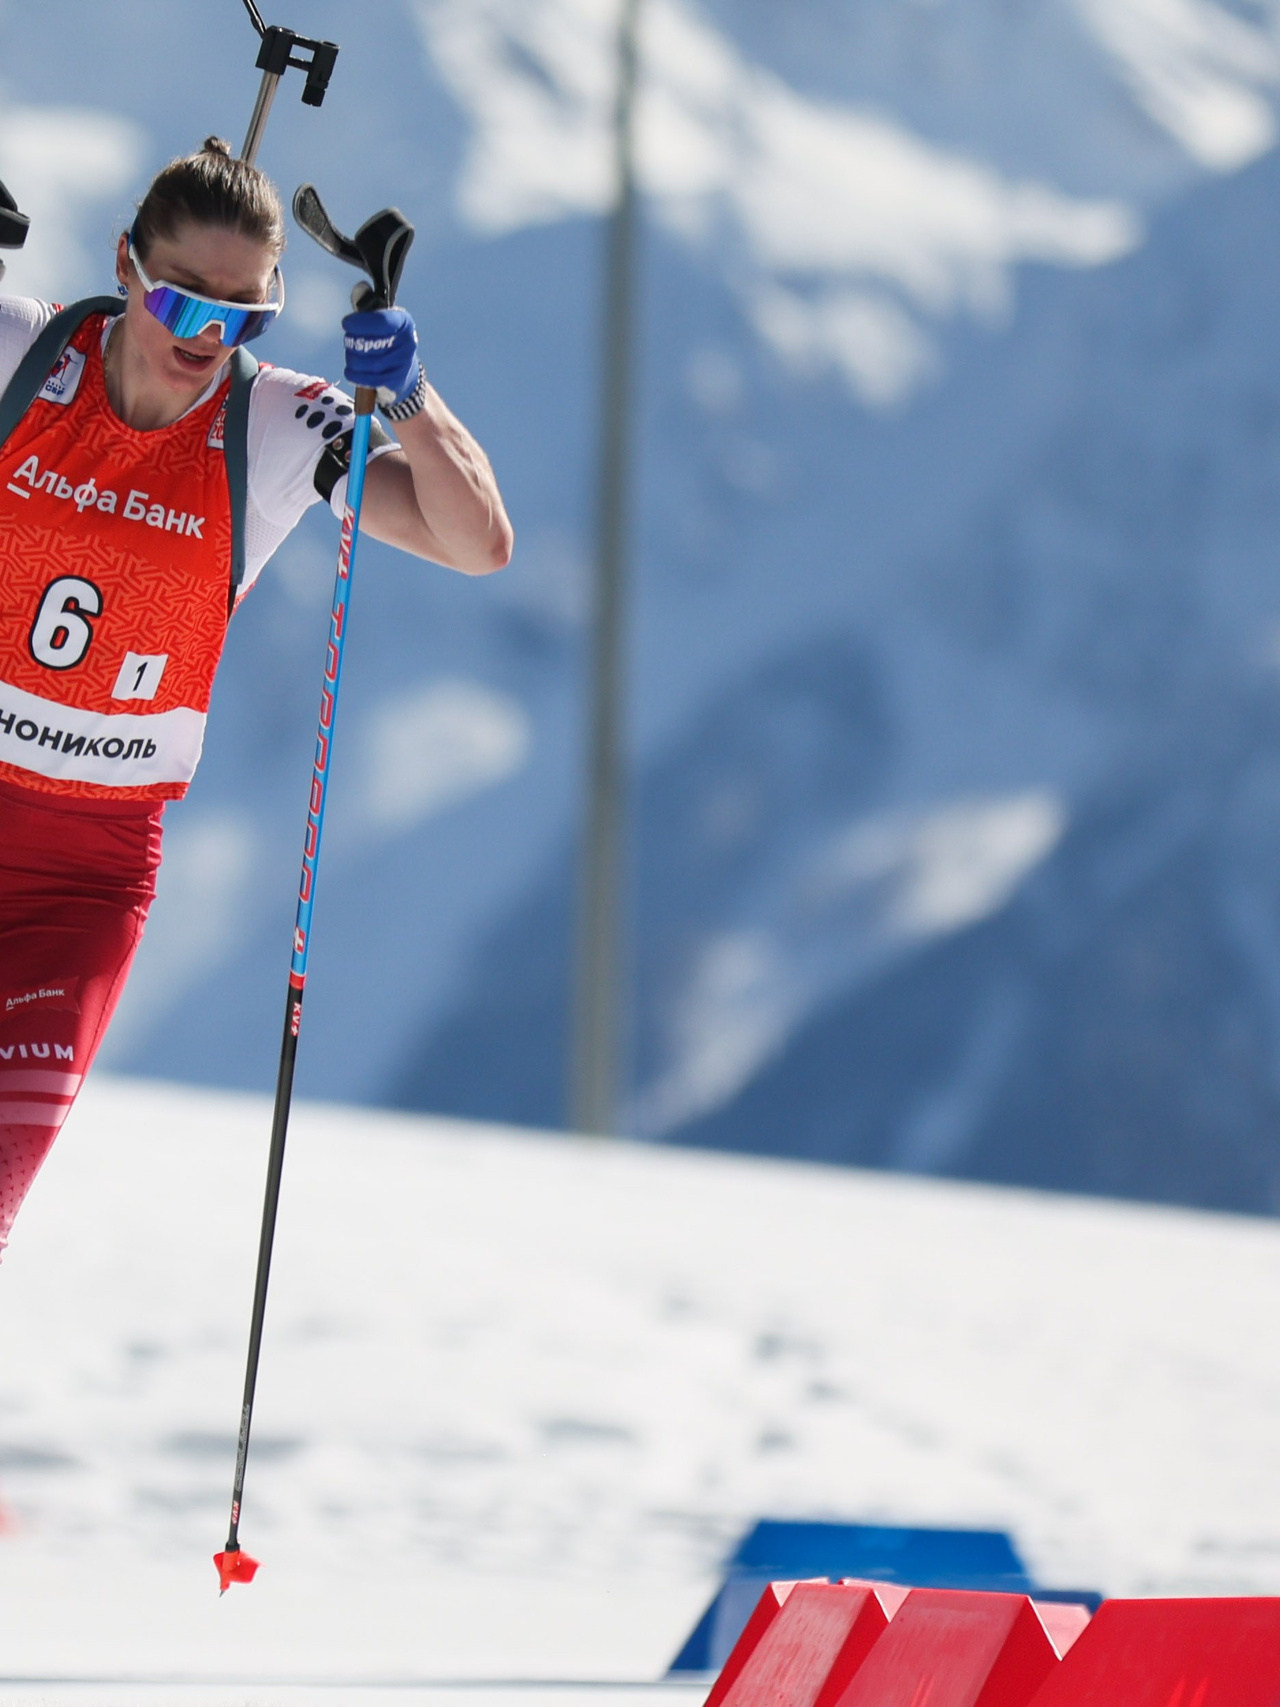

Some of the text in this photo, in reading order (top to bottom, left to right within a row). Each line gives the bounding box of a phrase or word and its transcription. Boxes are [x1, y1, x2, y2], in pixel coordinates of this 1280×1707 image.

[7, 455, 206, 540] Альфа Банк
[28, 575, 104, 671] 6
[131, 660, 149, 692] 1
[5, 988, 65, 1011] Альфа Банк
